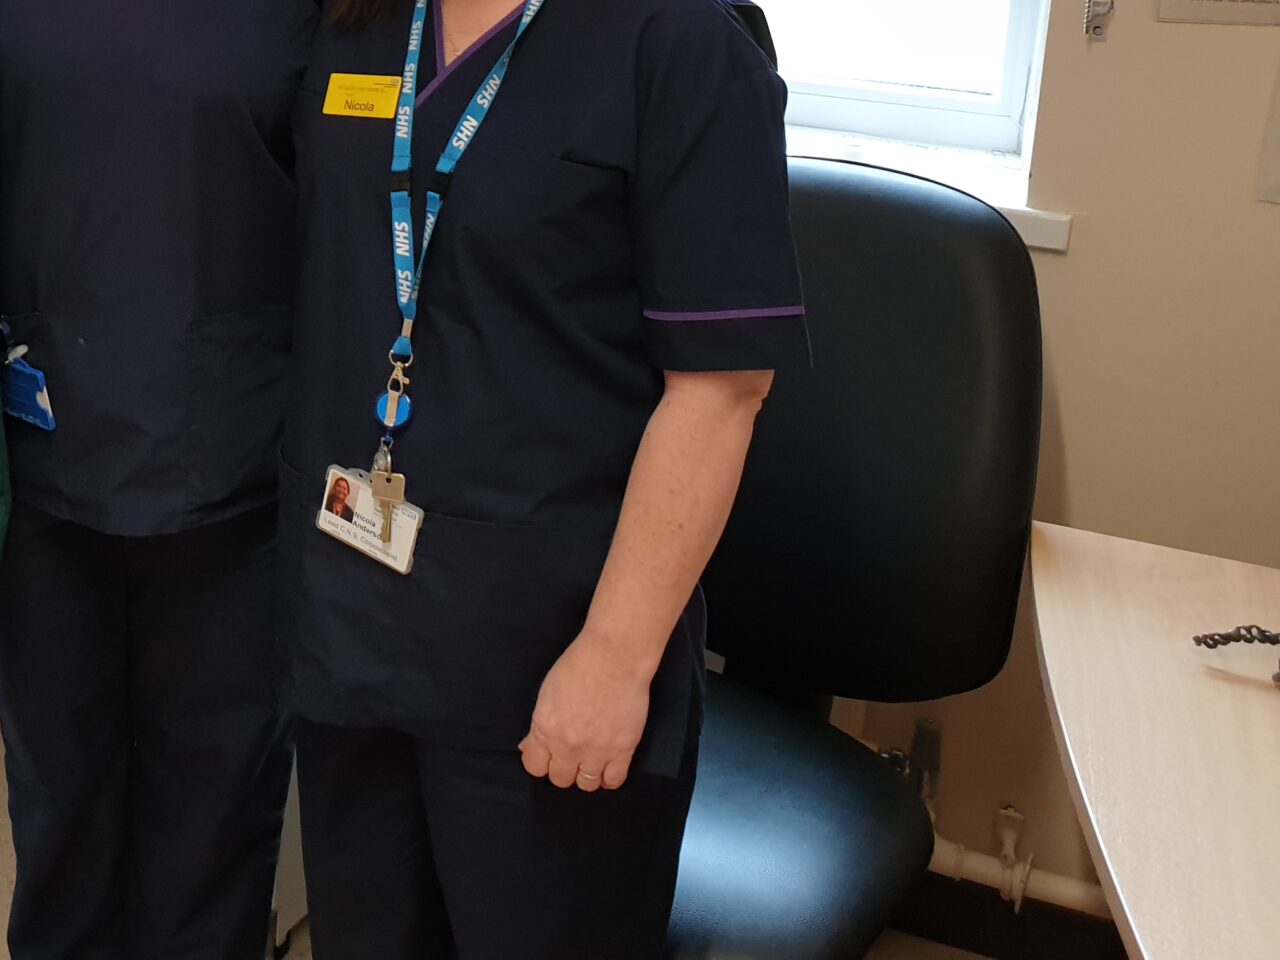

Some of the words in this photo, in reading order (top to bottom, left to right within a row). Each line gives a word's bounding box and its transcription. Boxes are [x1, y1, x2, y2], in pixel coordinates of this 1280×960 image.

[408, 20, 421, 51] NHS
[402, 63, 415, 93] NHS
[476, 74, 500, 108] NHS
[344, 100, 375, 112] Nicola
[396, 105, 410, 138] NHS
[452, 114, 479, 150] NHS
[394, 221, 410, 256] NHS
[397, 269, 412, 304] NHS
[354, 511, 376, 528] Nicola
